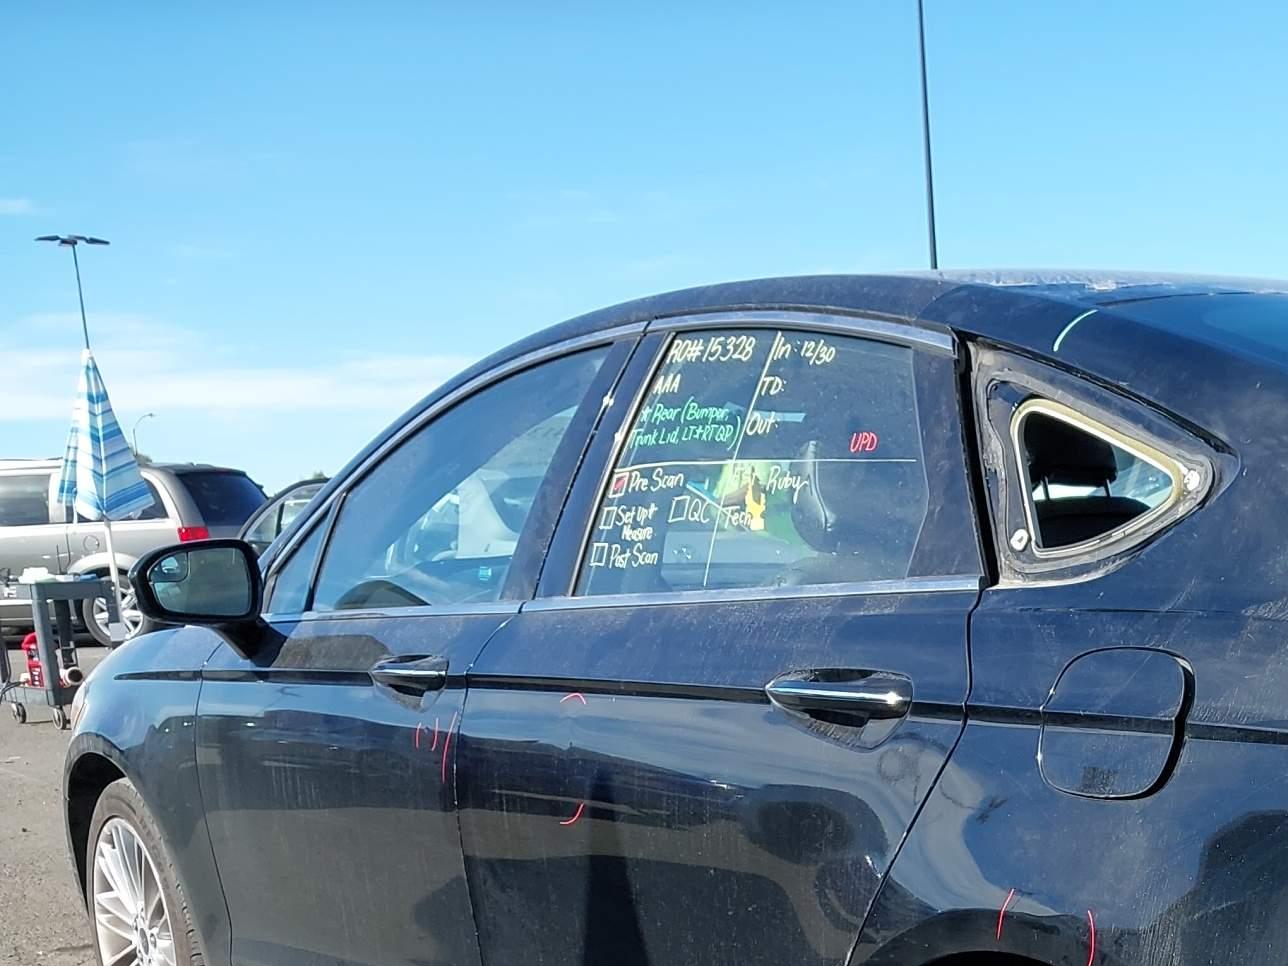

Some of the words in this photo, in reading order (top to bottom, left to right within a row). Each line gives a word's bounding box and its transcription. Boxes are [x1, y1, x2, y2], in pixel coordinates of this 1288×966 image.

[800, 340, 836, 366] 12/30
[653, 373, 682, 395] AAA
[760, 376, 788, 396] TD:
[746, 411, 779, 436] Out:
[628, 471, 649, 493] Pre
[650, 467, 685, 492] Scan
[766, 465, 808, 505] Ruby
[615, 505, 636, 527] Set
[688, 498, 710, 524] QC
[621, 523, 654, 542] Measure
[608, 543, 632, 569] Post
[631, 542, 659, 568] Scan
